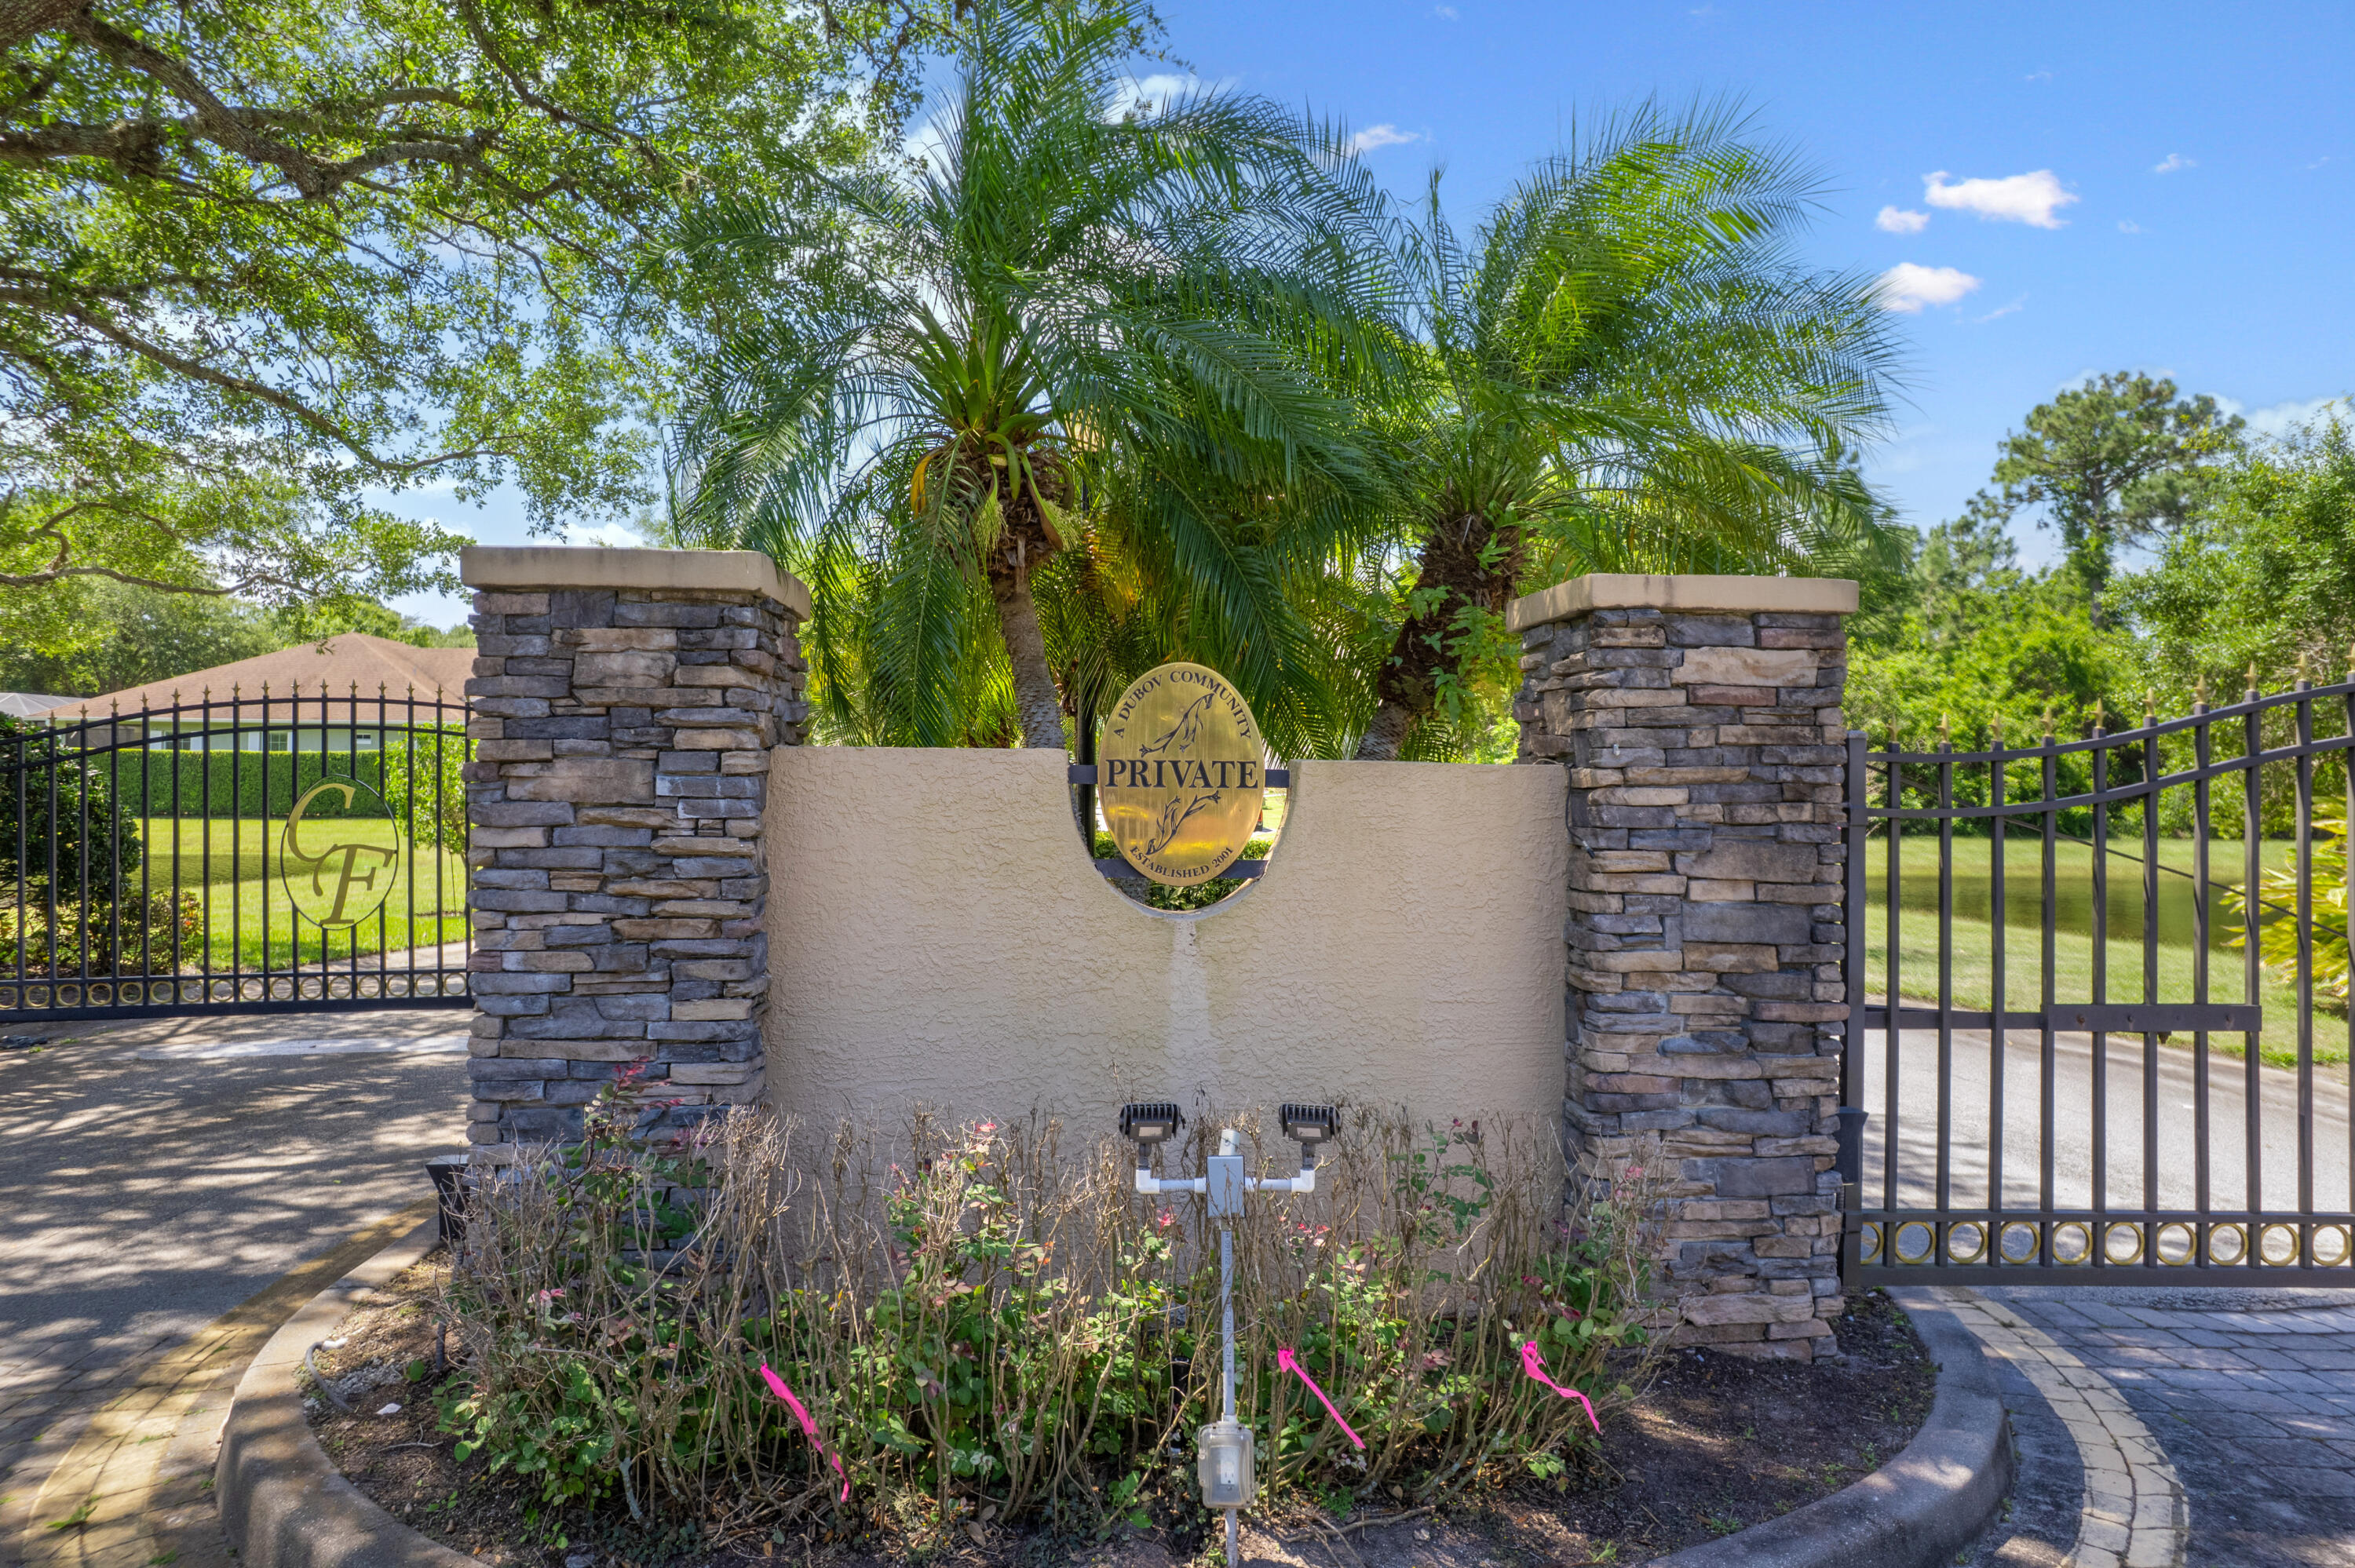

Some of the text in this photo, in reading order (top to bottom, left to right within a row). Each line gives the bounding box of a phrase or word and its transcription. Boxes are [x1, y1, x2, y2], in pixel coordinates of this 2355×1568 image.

[1113, 670, 1251, 739] A DUBOV COMMUNITY
[1104, 759, 1258, 789] PRIVATE
[1130, 846, 1234, 878] ESTABLISHED 2001
